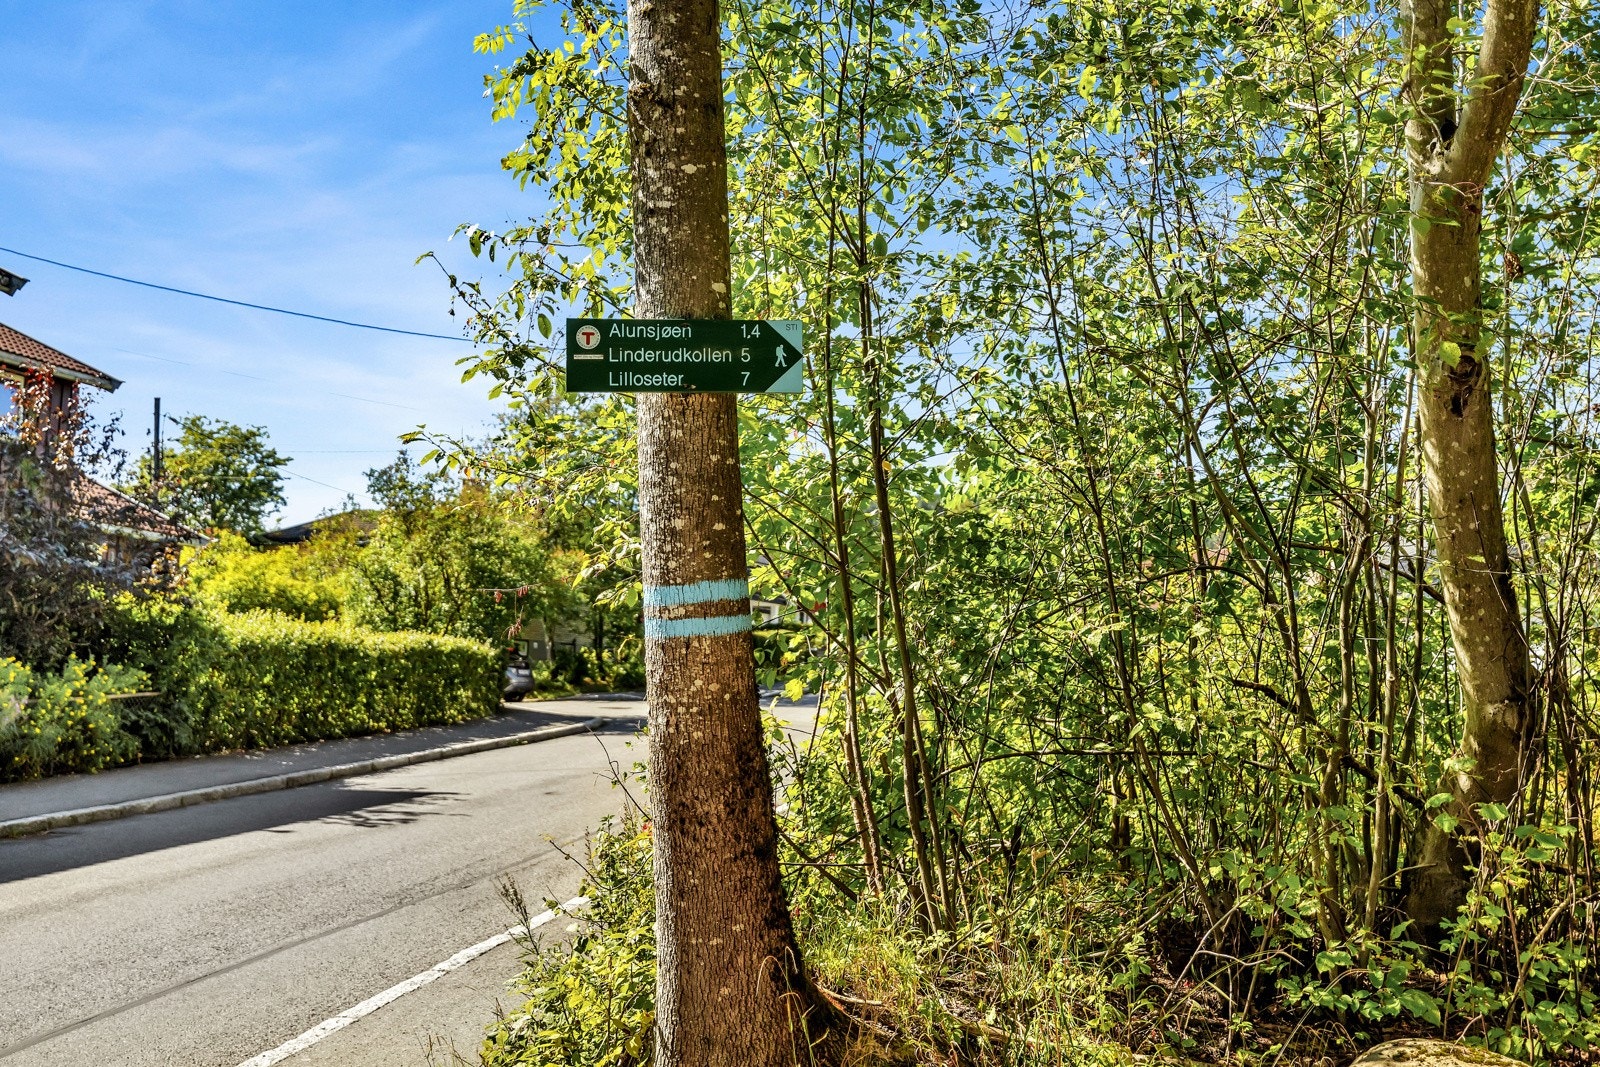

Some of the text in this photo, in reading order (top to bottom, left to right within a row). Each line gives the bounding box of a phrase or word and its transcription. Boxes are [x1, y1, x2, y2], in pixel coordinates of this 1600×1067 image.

[608, 323, 692, 341] Alunsjøen
[740, 324, 761, 340] 1,4
[785, 323, 798, 331] STI
[581, 331, 595, 346] T
[608, 347, 751, 363] Linderudkollen 5
[608, 371, 751, 387] Lilloseter 7
